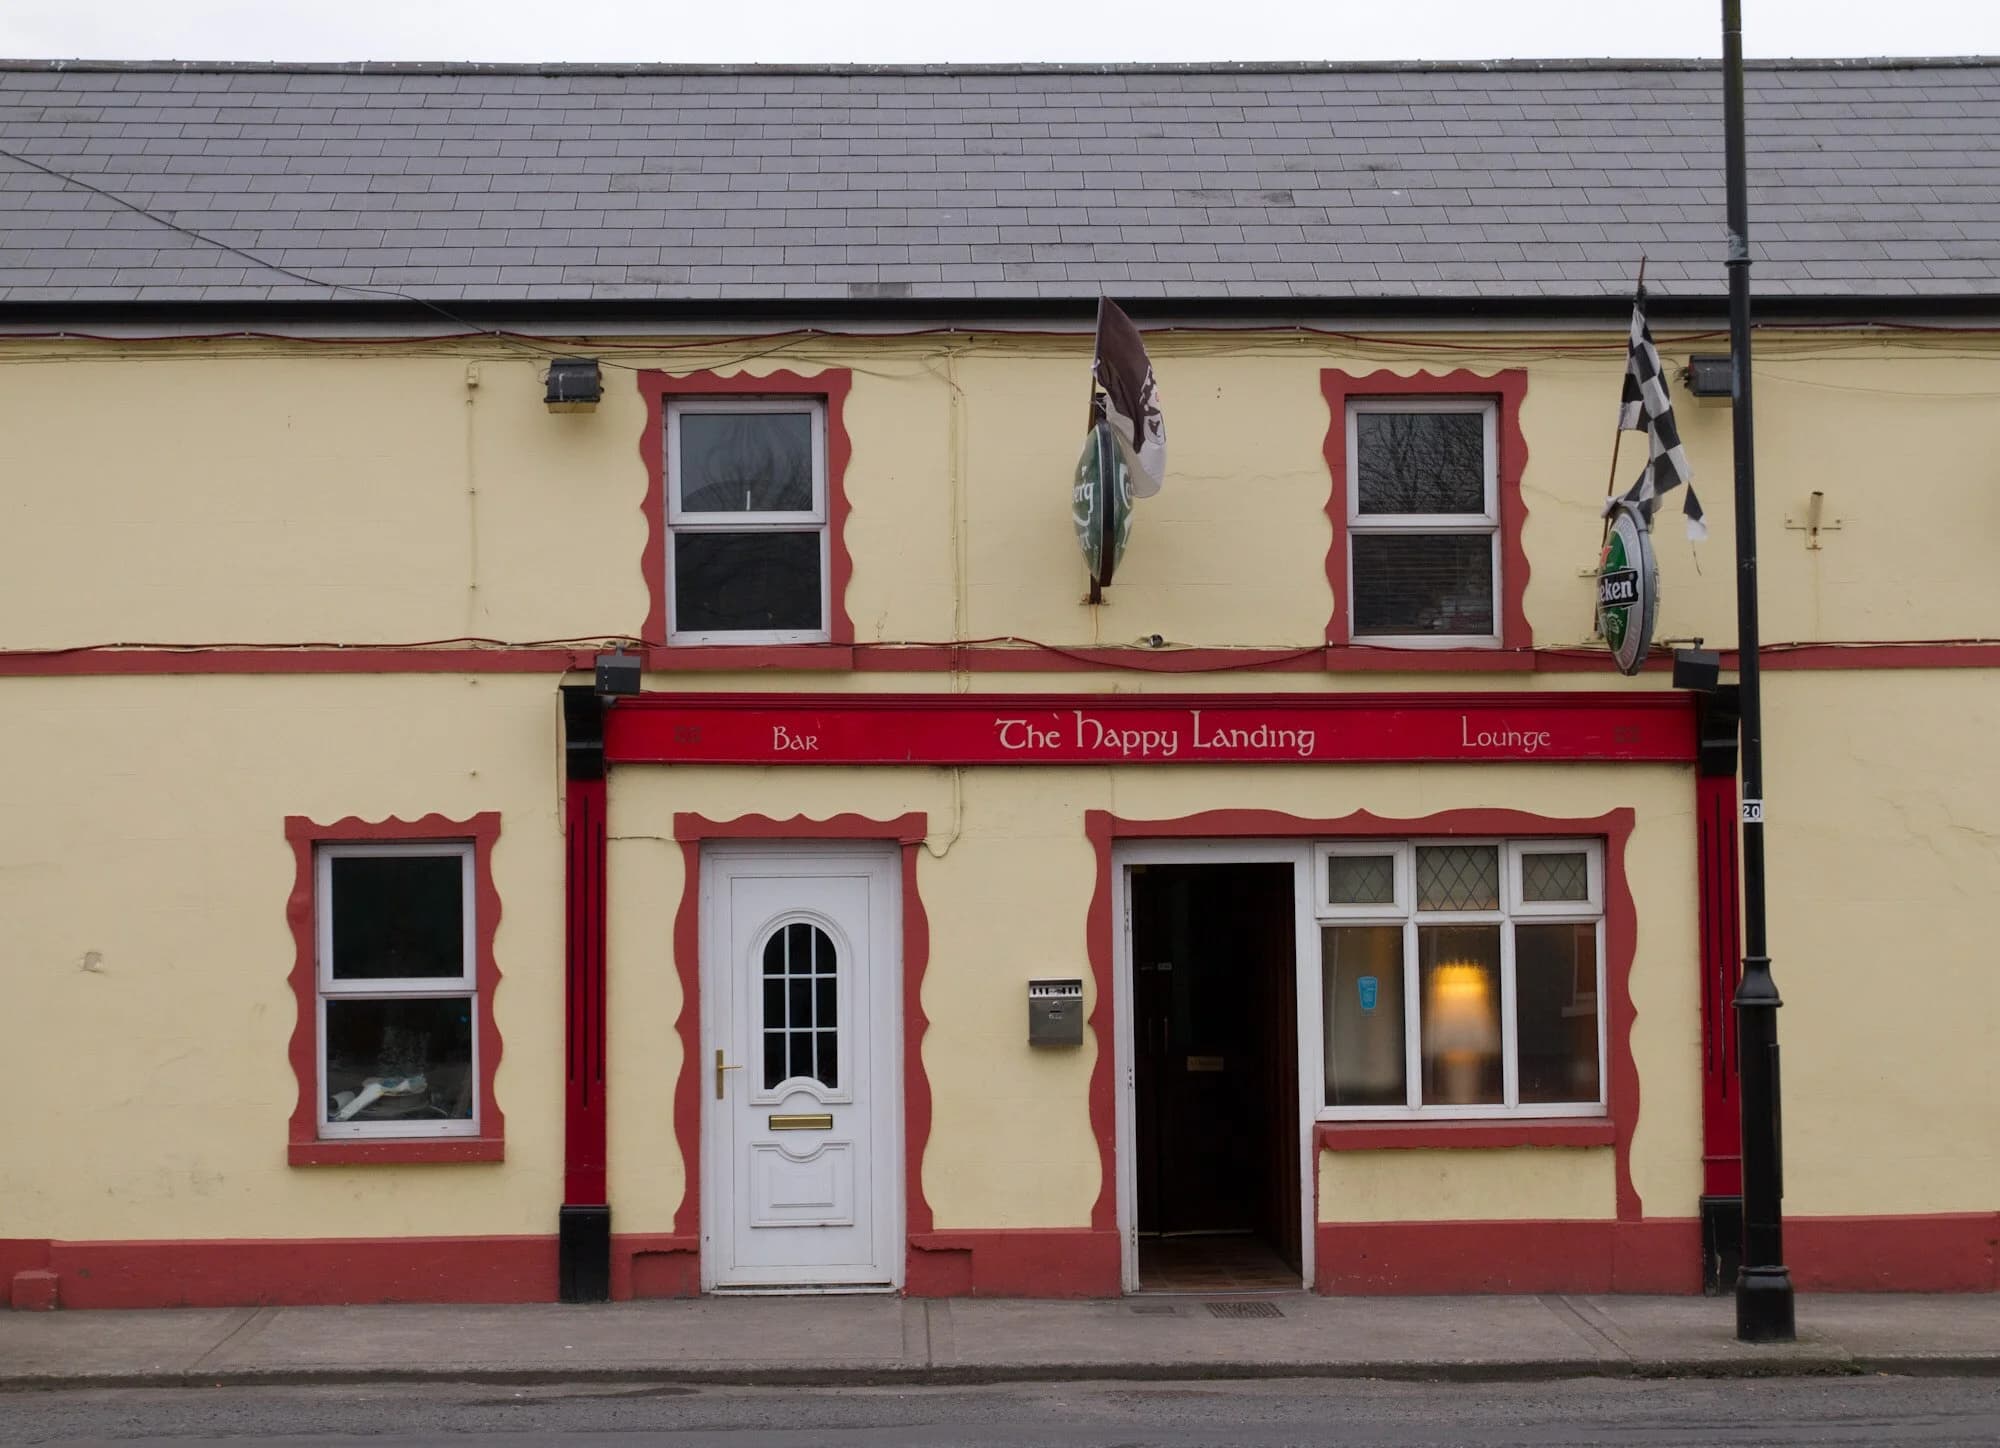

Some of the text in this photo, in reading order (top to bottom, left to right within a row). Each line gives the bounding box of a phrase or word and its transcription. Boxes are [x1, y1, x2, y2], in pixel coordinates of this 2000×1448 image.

[994, 710, 1316, 756] The Happy Landing
[1462, 716, 1551, 753] Lounge
[1743, 804, 1760, 818] 20
